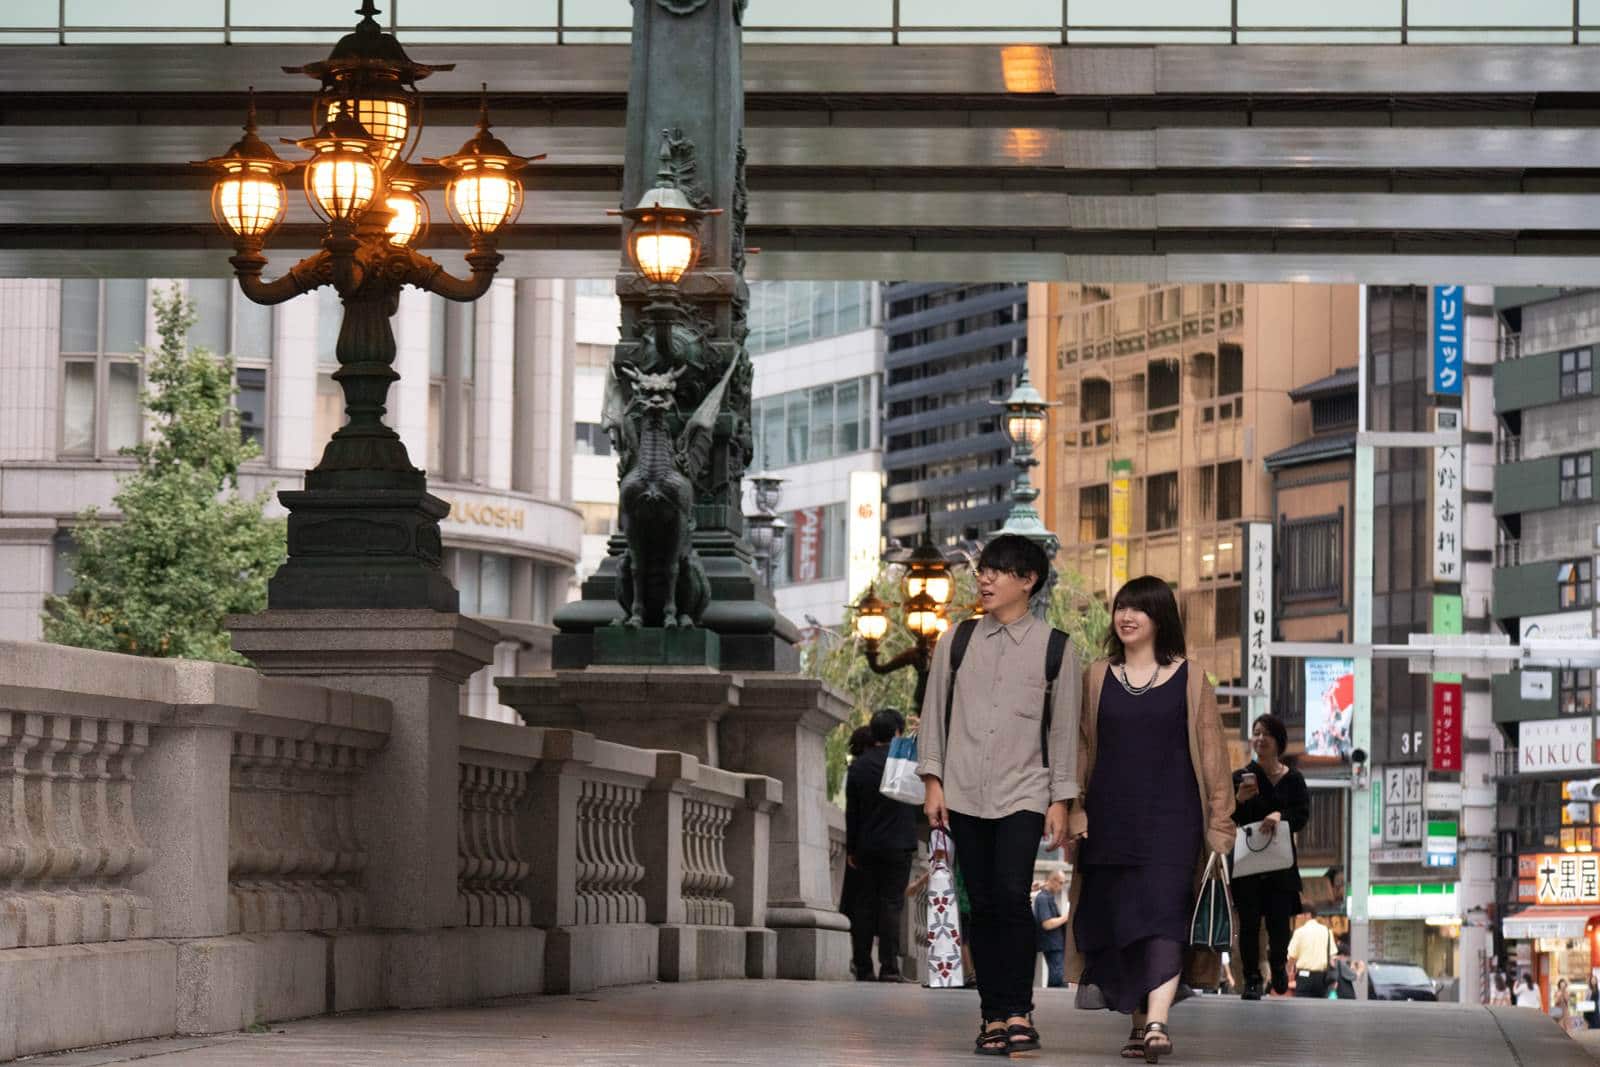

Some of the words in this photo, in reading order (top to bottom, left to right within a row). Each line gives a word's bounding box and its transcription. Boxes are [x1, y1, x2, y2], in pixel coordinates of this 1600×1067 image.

[451, 500, 525, 530] UKOSHI
[1439, 562, 1456, 575] 3F
[1401, 731, 1422, 754] 3F
[1540, 858, 1597, 897] 大黒屋
